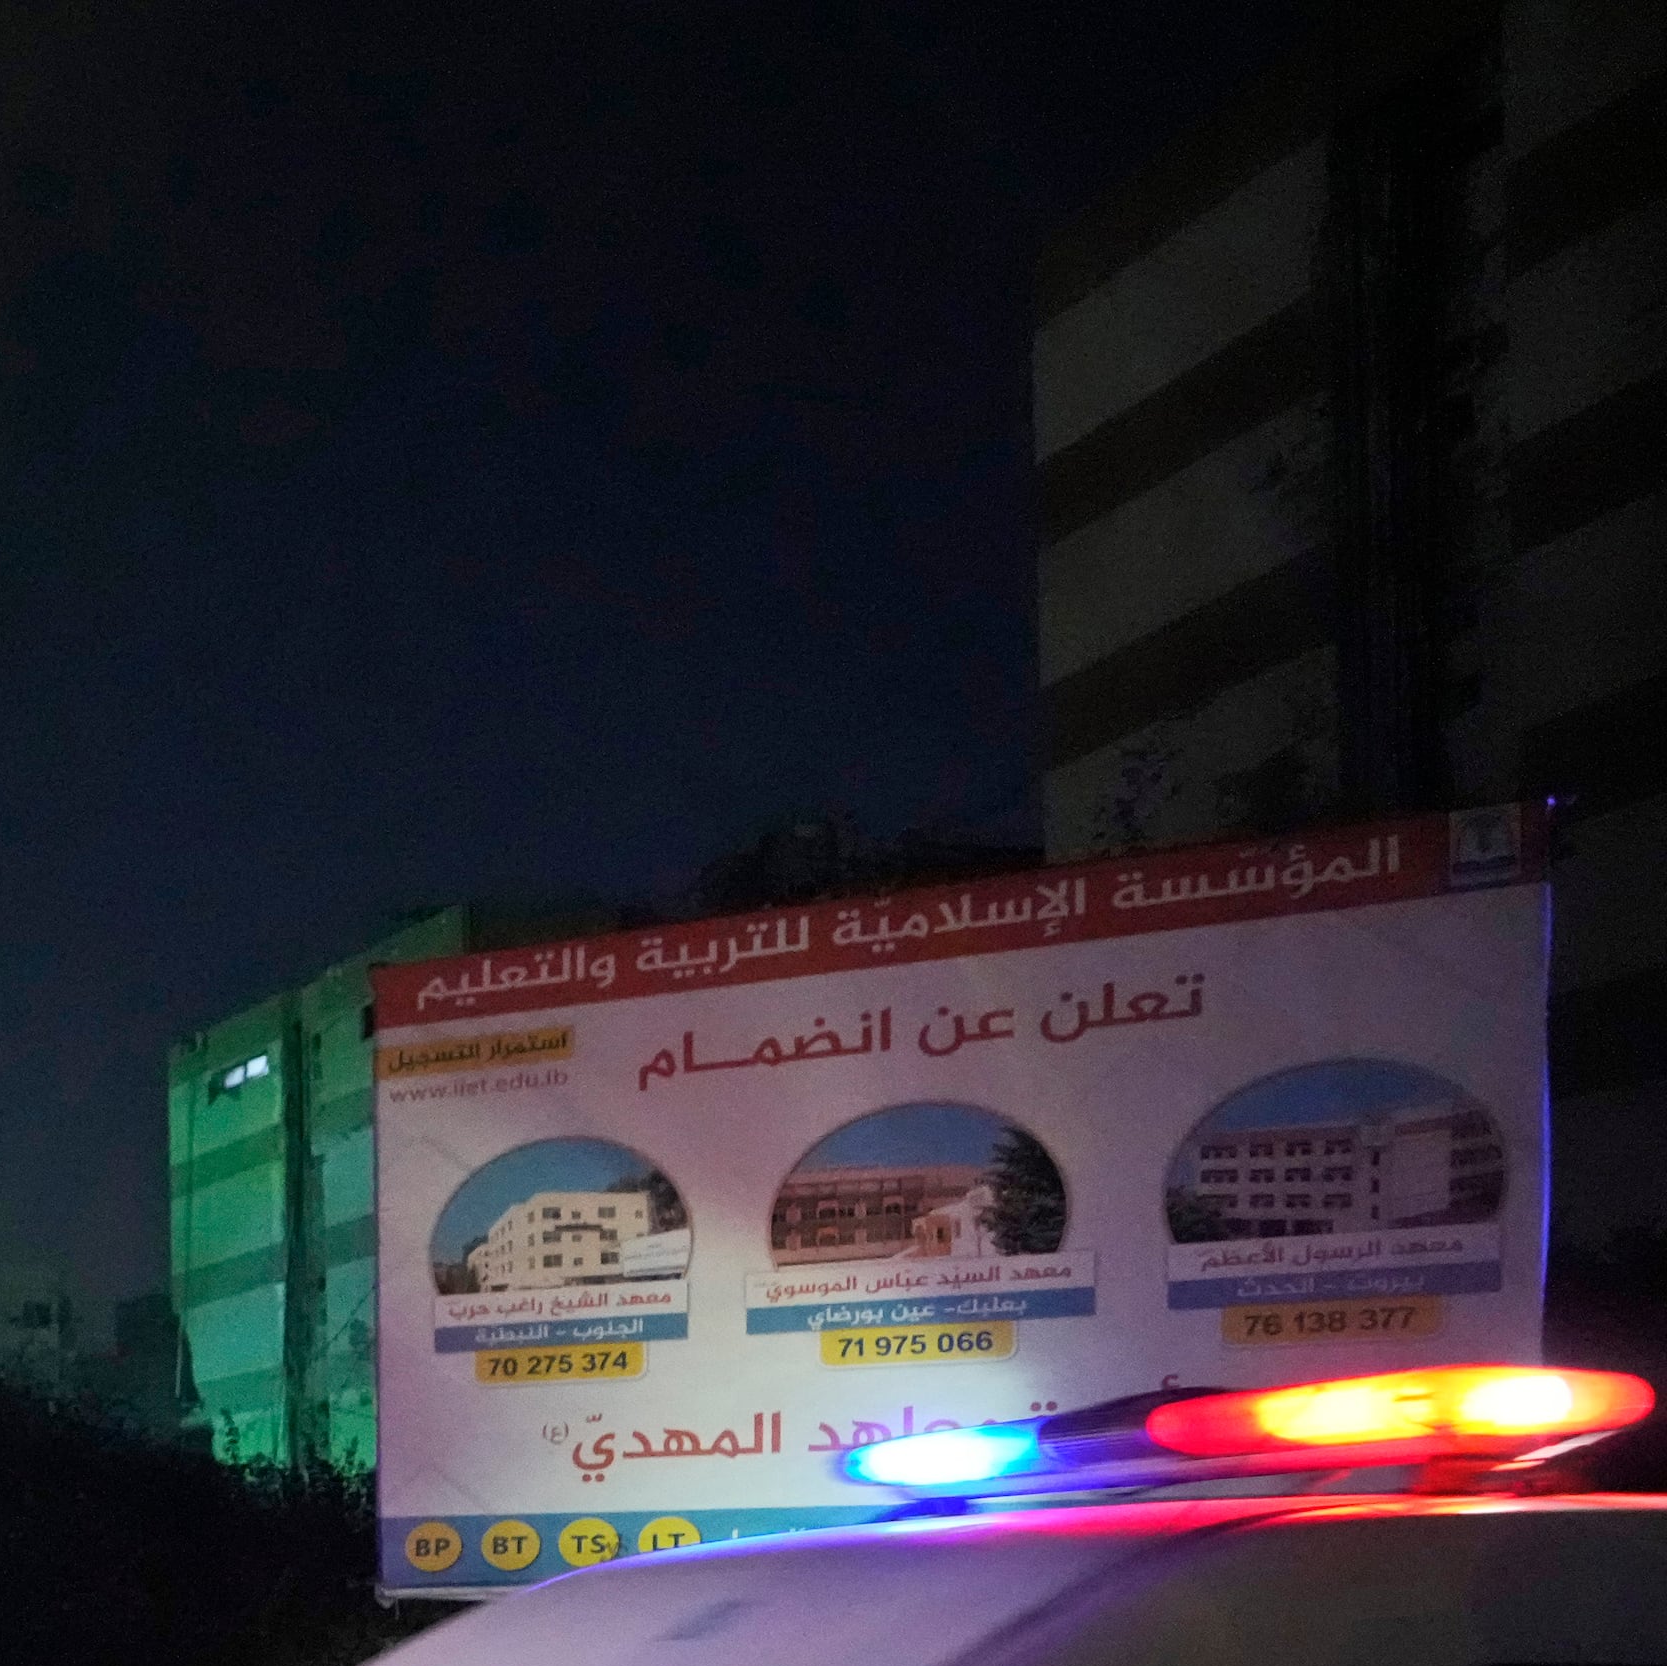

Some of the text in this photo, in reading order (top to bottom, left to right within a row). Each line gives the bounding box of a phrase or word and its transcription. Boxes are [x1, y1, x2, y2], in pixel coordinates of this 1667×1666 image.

[636, 916, 810, 978] للتربية
[416, 948, 617, 1010] والتعليم
[1040, 973, 1206, 1043] تعلن
[918, 1006, 1015, 1057] عن
[389, 1031, 567, 1074] استمرار التسجيل
[1292, 1239, 1381, 1266] الرسول
[1010, 1266, 1072, 1281] معهد
[448, 1291, 671, 1321] معهد الشيخ راغب حرب
[890, 1304, 936, 1322] عين
[572, 1317, 644, 1341] الجنوب
[1244, 1306, 1417, 1336] 76 138 377
[838, 1331, 994, 1357] 71 975 066
[488, 1351, 629, 1377] 70 275 374
[415, 1532, 686, 1557] BP BT TS LT
